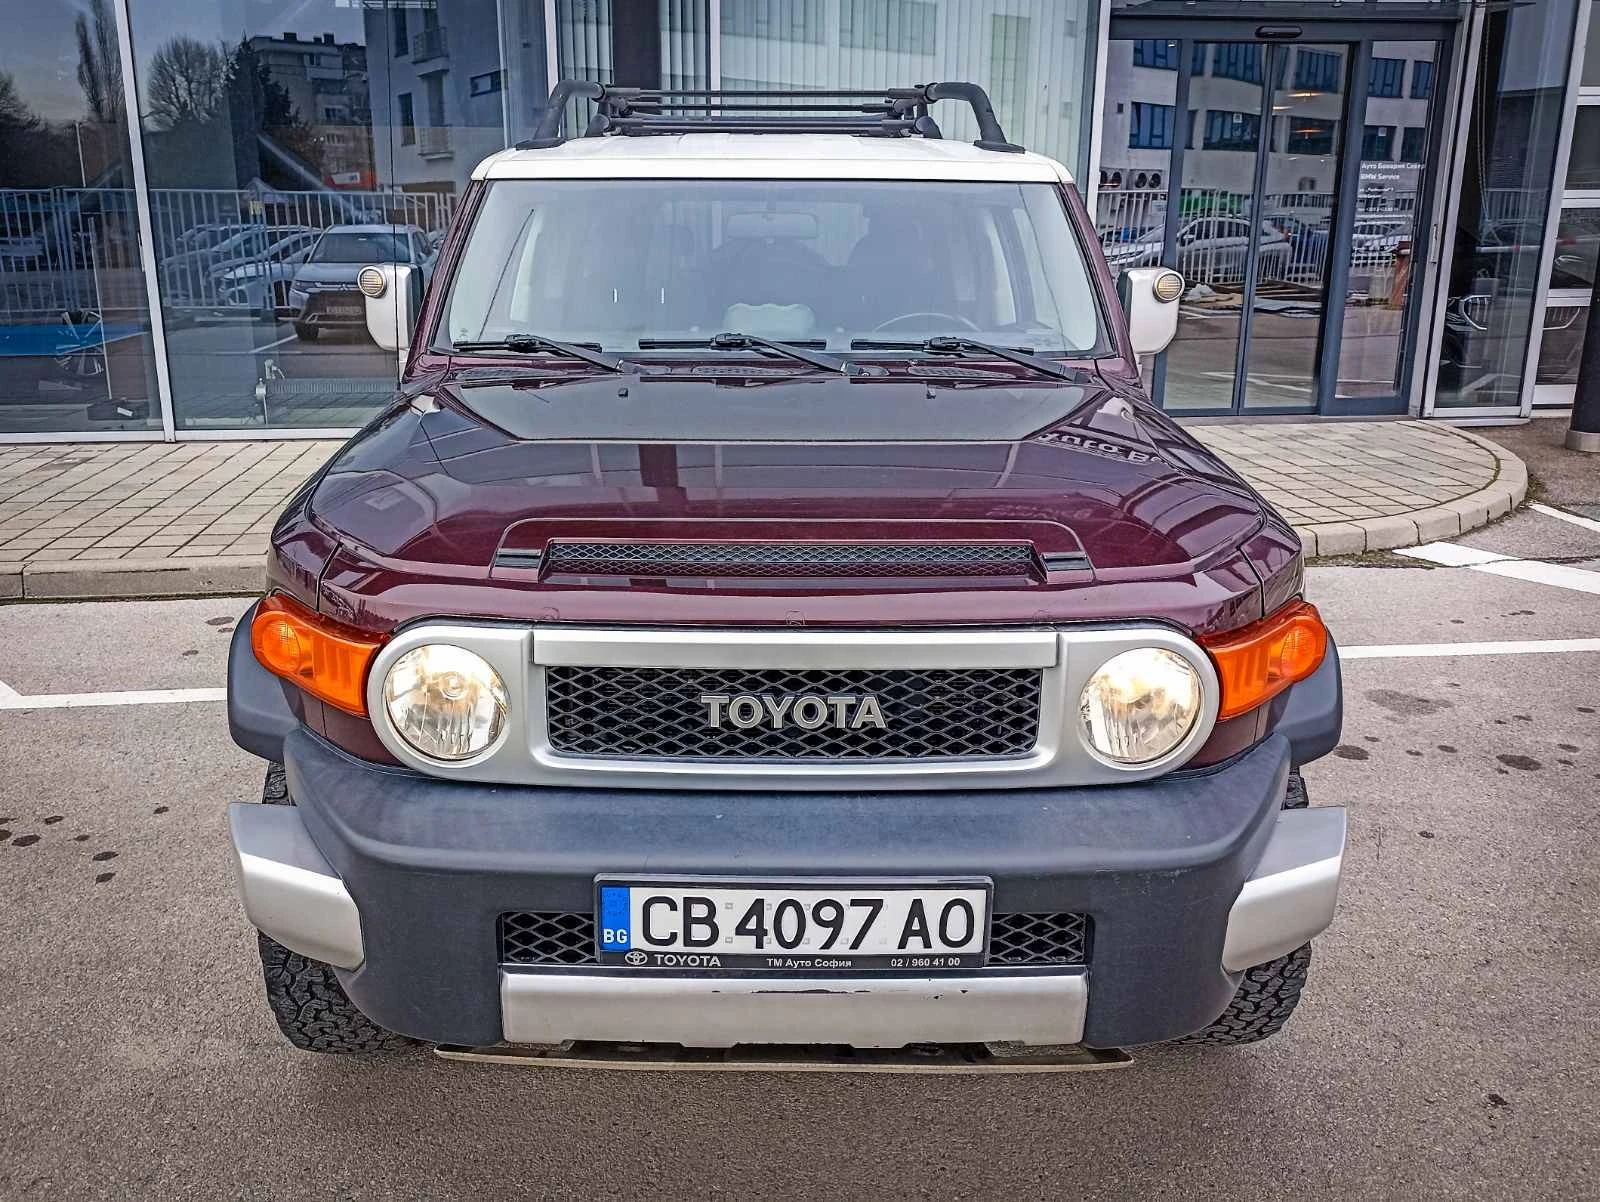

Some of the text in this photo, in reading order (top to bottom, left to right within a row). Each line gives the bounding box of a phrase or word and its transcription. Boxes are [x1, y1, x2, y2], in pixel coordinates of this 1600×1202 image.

[701, 695, 887, 729] TOYOTA
[642, 896, 975, 949] CB 4097 AO
[603, 928, 628, 944] BG
[654, 954, 722, 967] TOYOTA
[785, 958, 812, 969] Ауто
[814, 958, 852, 969] София
[890, 958, 903, 967] 02
[911, 958, 930, 967] 960
[932, 957, 945, 966] 41
[947, 957, 961, 966] 00
